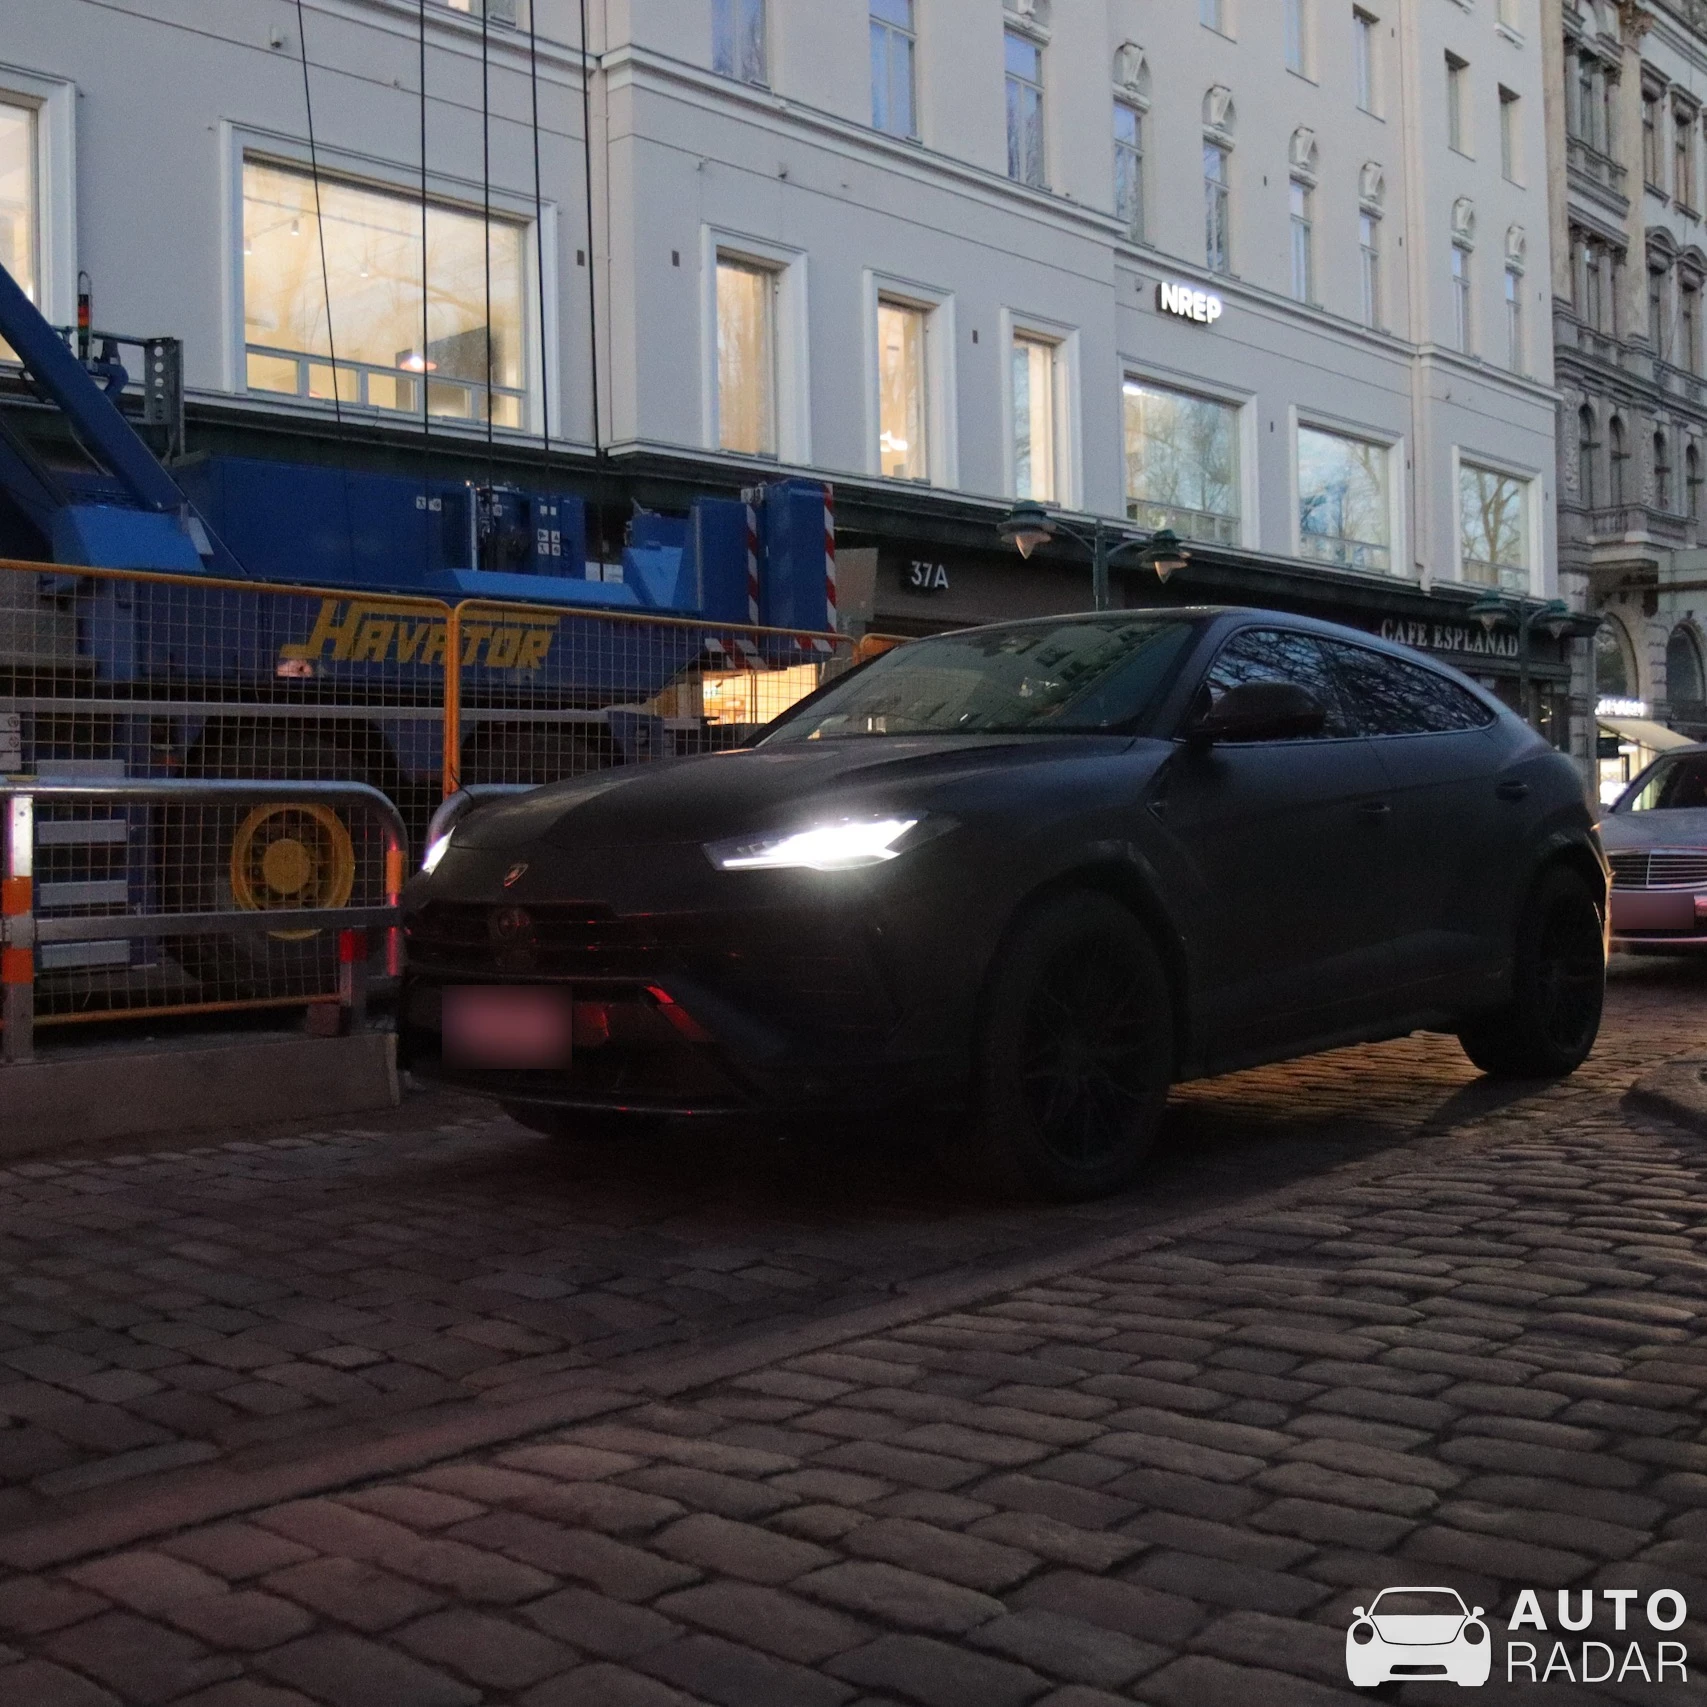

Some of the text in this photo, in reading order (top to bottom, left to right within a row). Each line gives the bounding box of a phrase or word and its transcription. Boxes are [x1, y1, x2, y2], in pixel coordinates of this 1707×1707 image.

[1161, 281, 1221, 324] NREP
[911, 560, 949, 589] 37A
[1433, 625, 1519, 657] ESPLANAD
